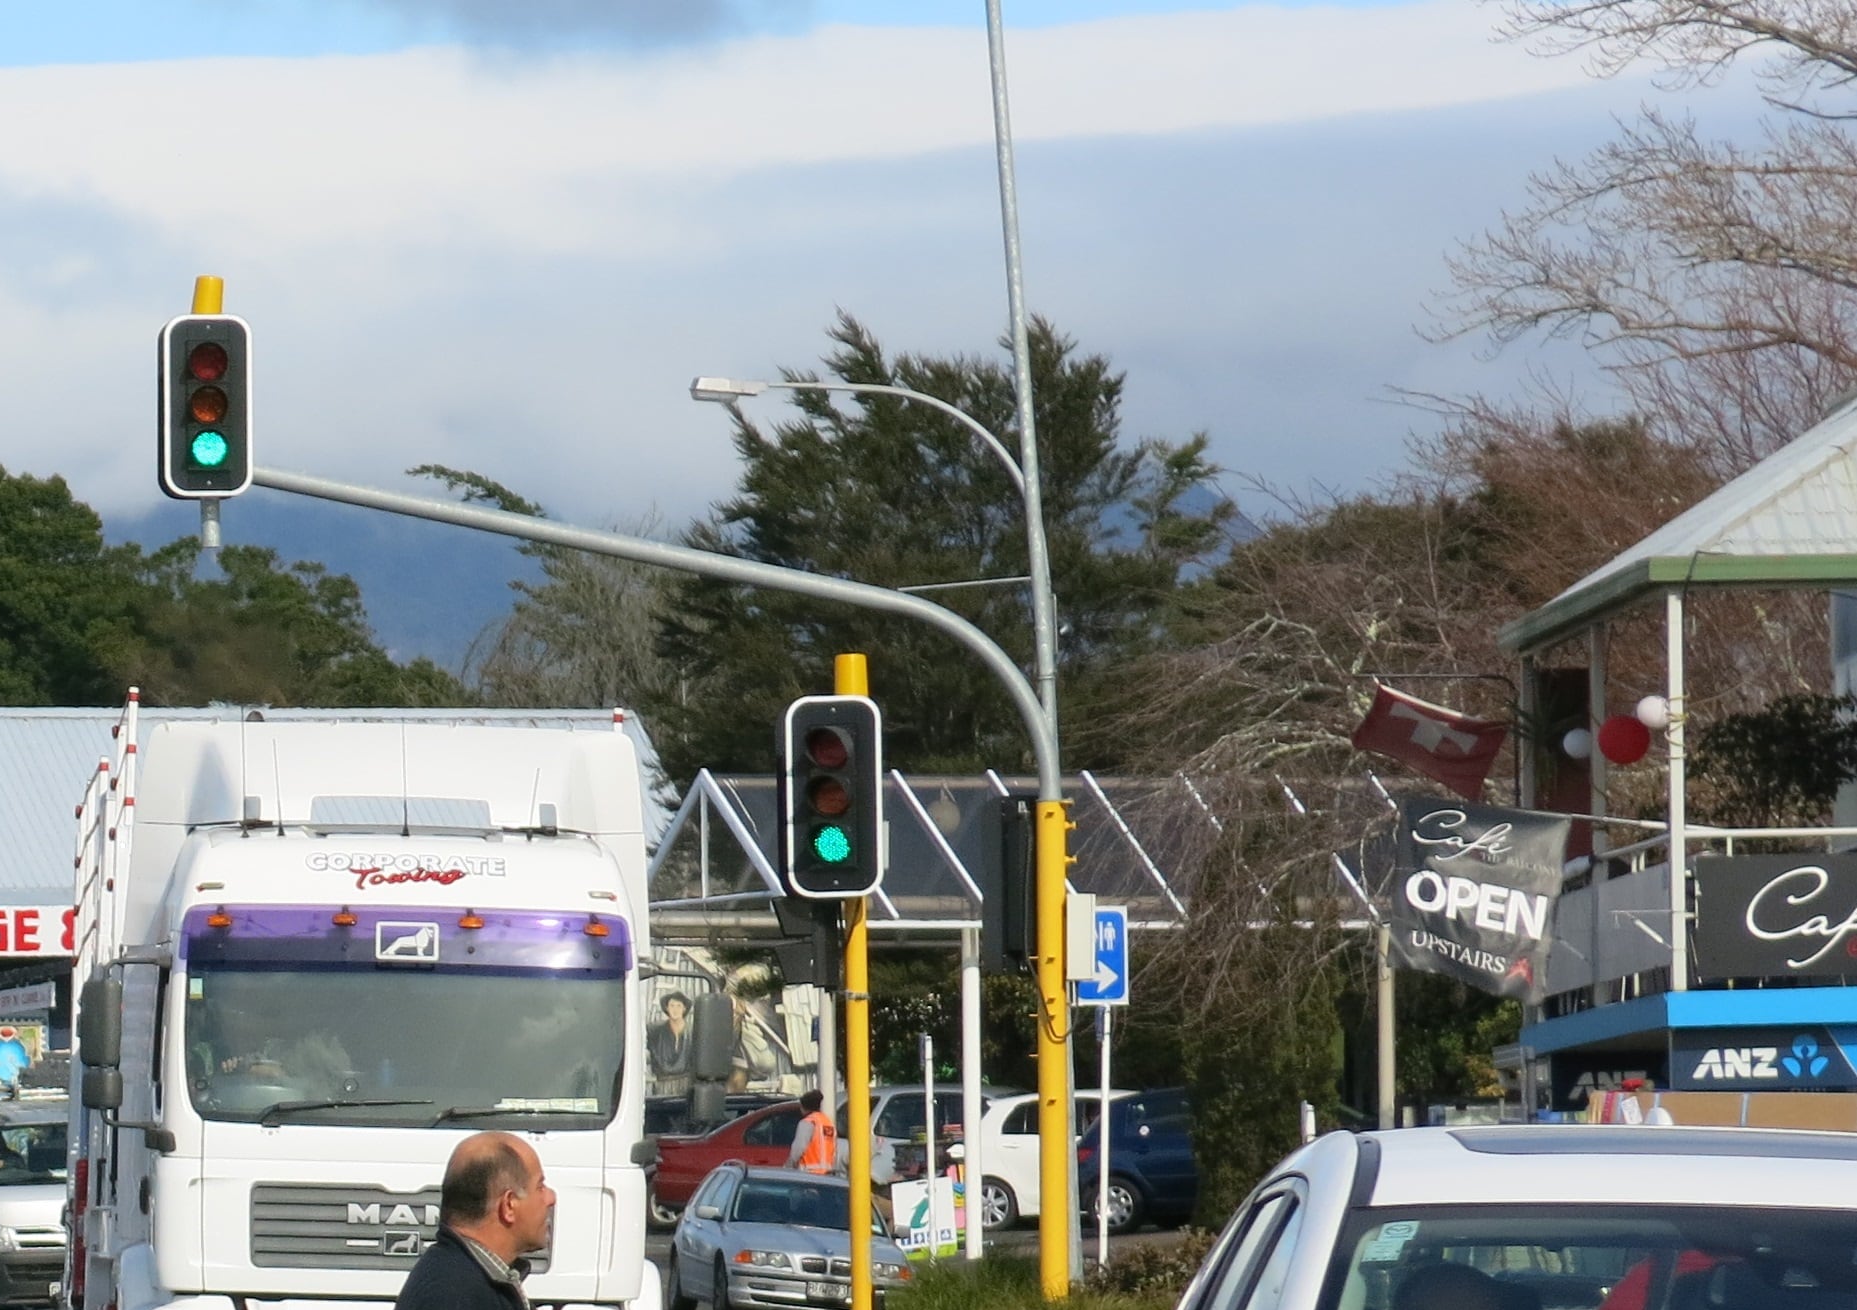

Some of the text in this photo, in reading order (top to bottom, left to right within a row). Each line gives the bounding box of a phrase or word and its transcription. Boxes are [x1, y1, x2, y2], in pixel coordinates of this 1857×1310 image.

[1412, 809, 1513, 861] Café
[305, 852, 506, 877] CORPORATE
[349, 867, 466, 890] Towing
[1406, 870, 1548, 941] OPEN
[1411, 930, 1507, 974] UPSTAIRS
[1693, 1048, 1778, 1079] ANZ
